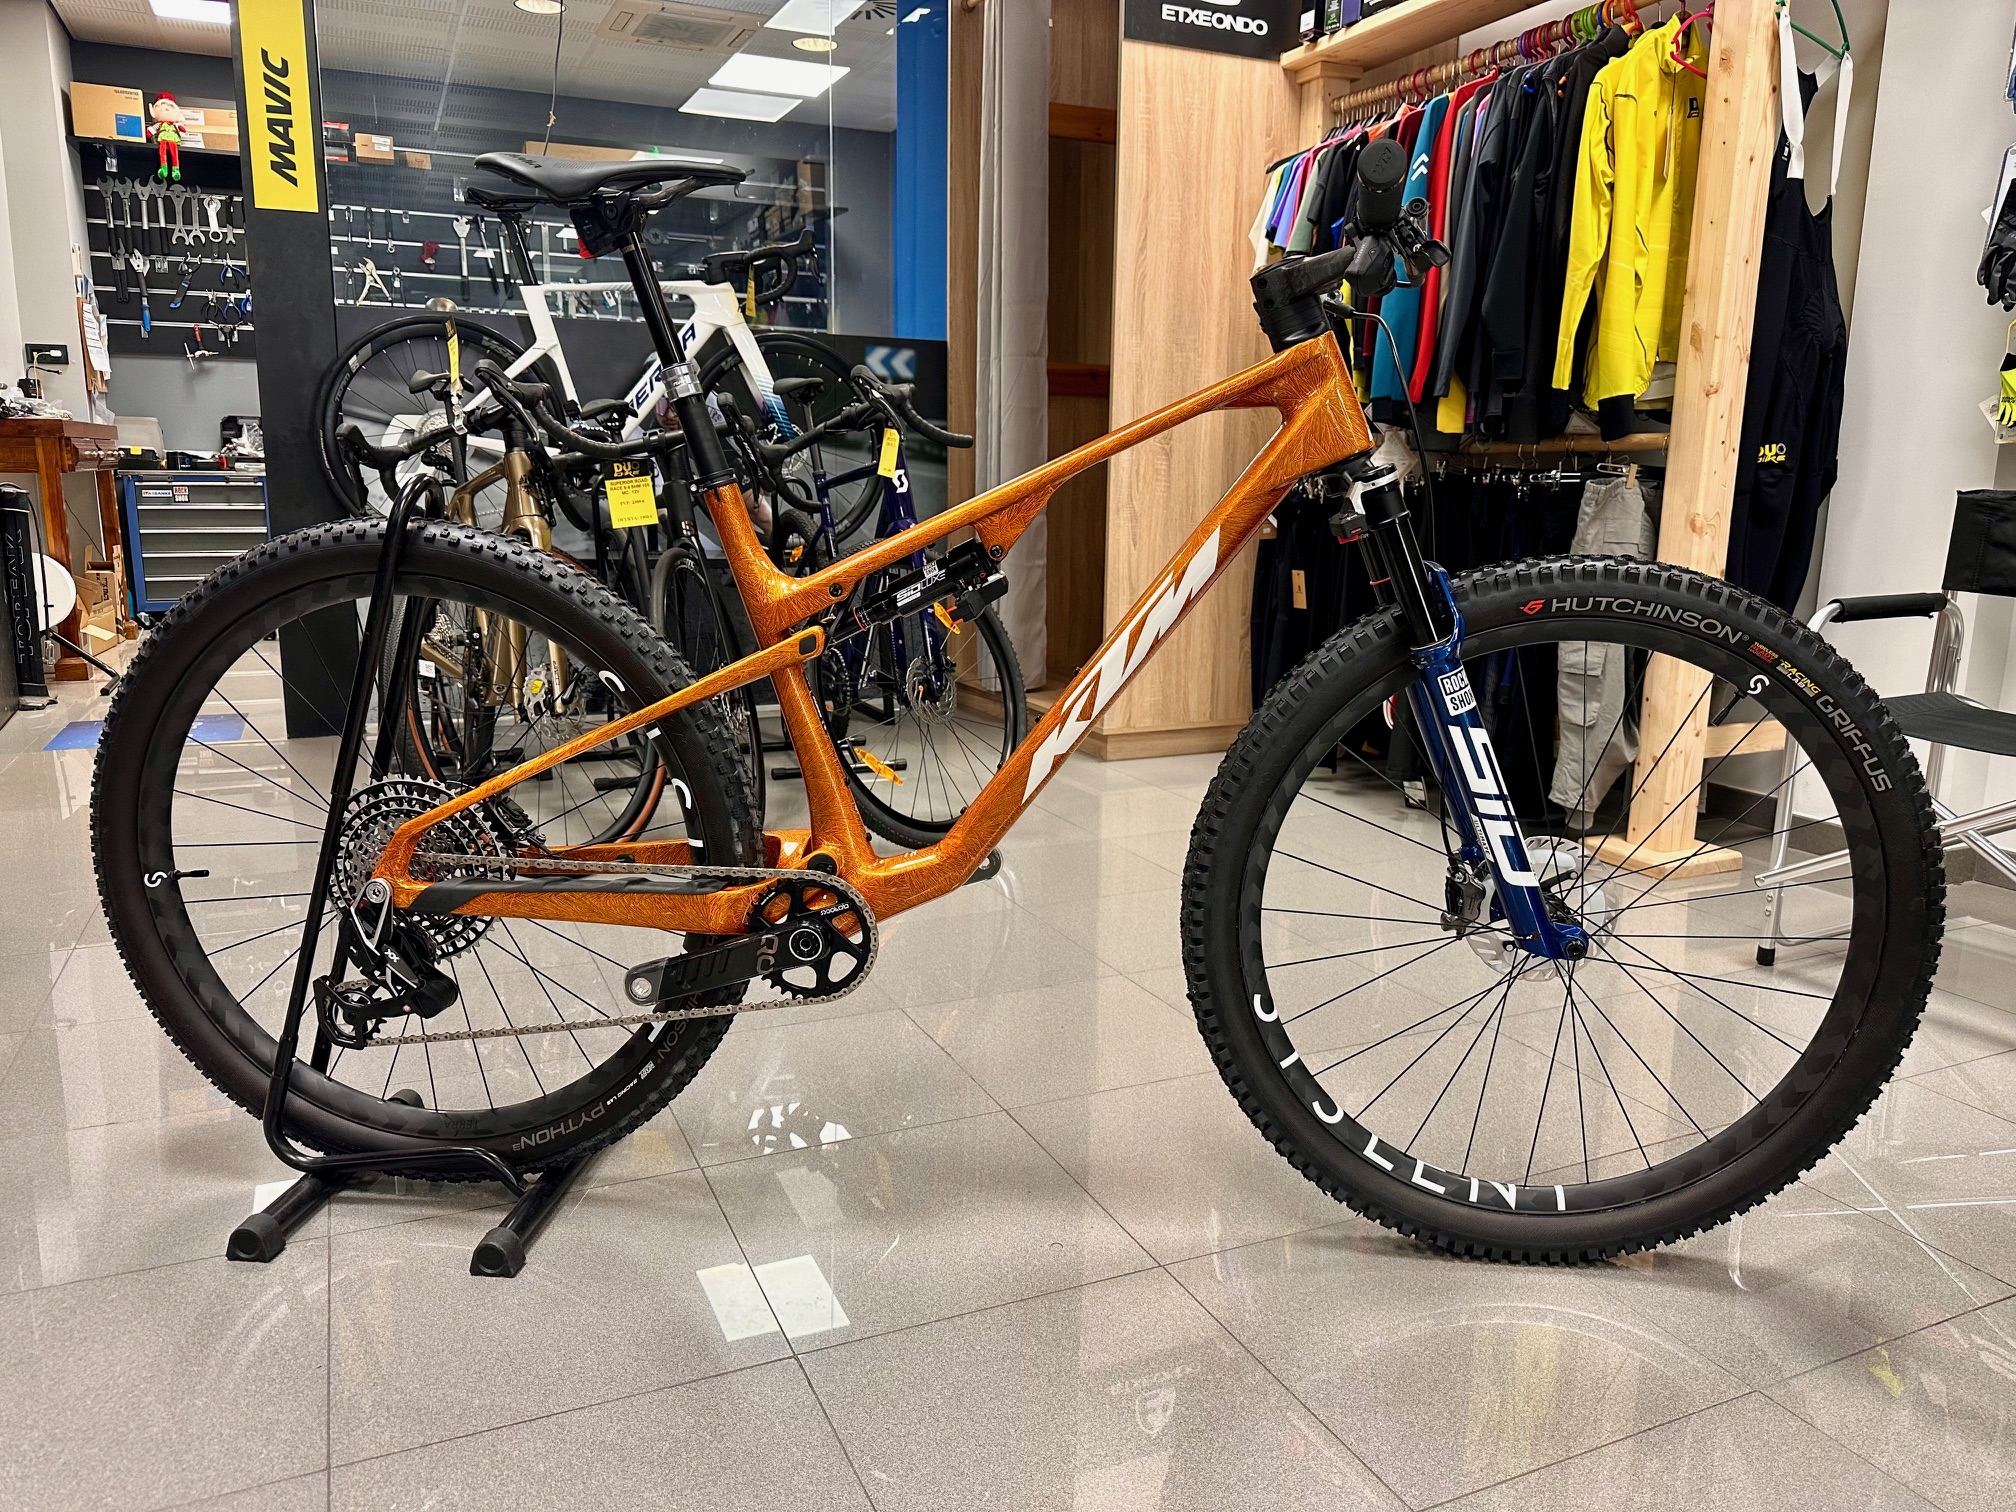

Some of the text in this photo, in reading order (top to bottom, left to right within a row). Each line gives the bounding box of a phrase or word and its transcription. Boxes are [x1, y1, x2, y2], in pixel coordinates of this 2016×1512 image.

[1161, 4, 1269, 36] ETXEONDO
[260, 47, 298, 187] MAVIC
[4, 528, 34, 664] TOPEAK
[1551, 596, 1744, 645] HUTCHINSON
[1021, 524, 1221, 805] KTM
[1780, 660, 1822, 695] RACING
[1786, 672, 1806, 690] LAB
[1815, 694, 1893, 792] GRIFFUS
[606, 1078, 638, 1106] RACING LAB
[442, 1118, 479, 1130] TERRA
